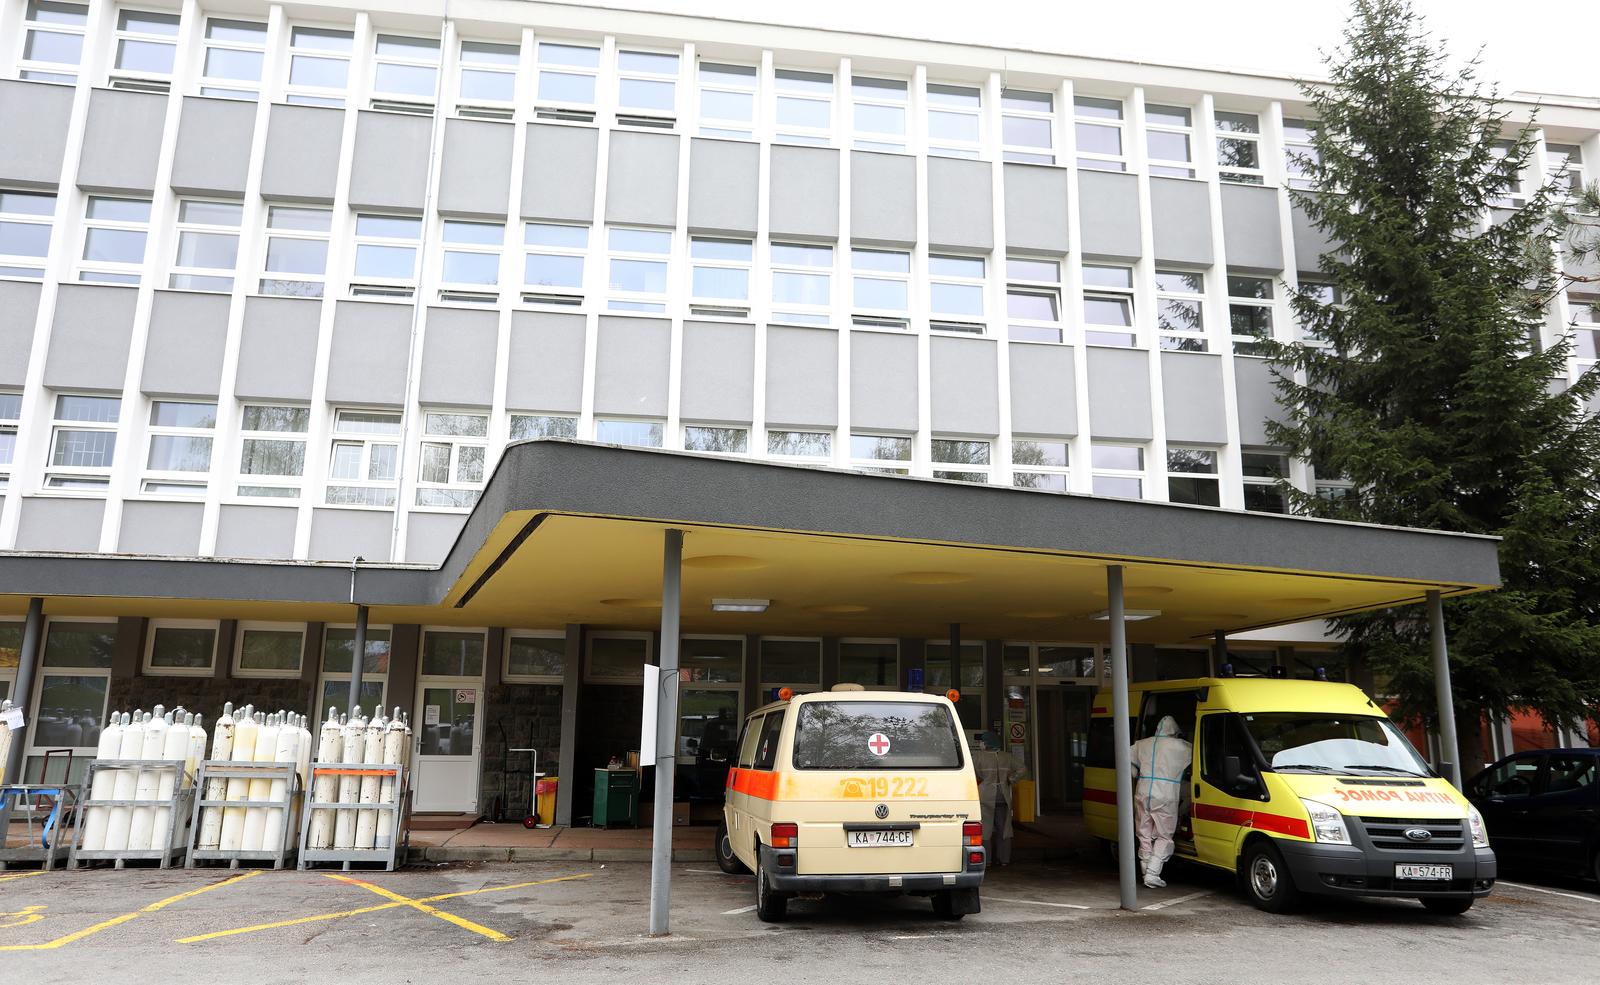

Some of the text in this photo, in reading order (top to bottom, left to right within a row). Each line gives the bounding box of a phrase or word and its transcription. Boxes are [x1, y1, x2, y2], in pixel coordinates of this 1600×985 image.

[867, 776, 929, 798] 19 222
[855, 832, 869, 844] KA
[1401, 866, 1413, 877] KA
